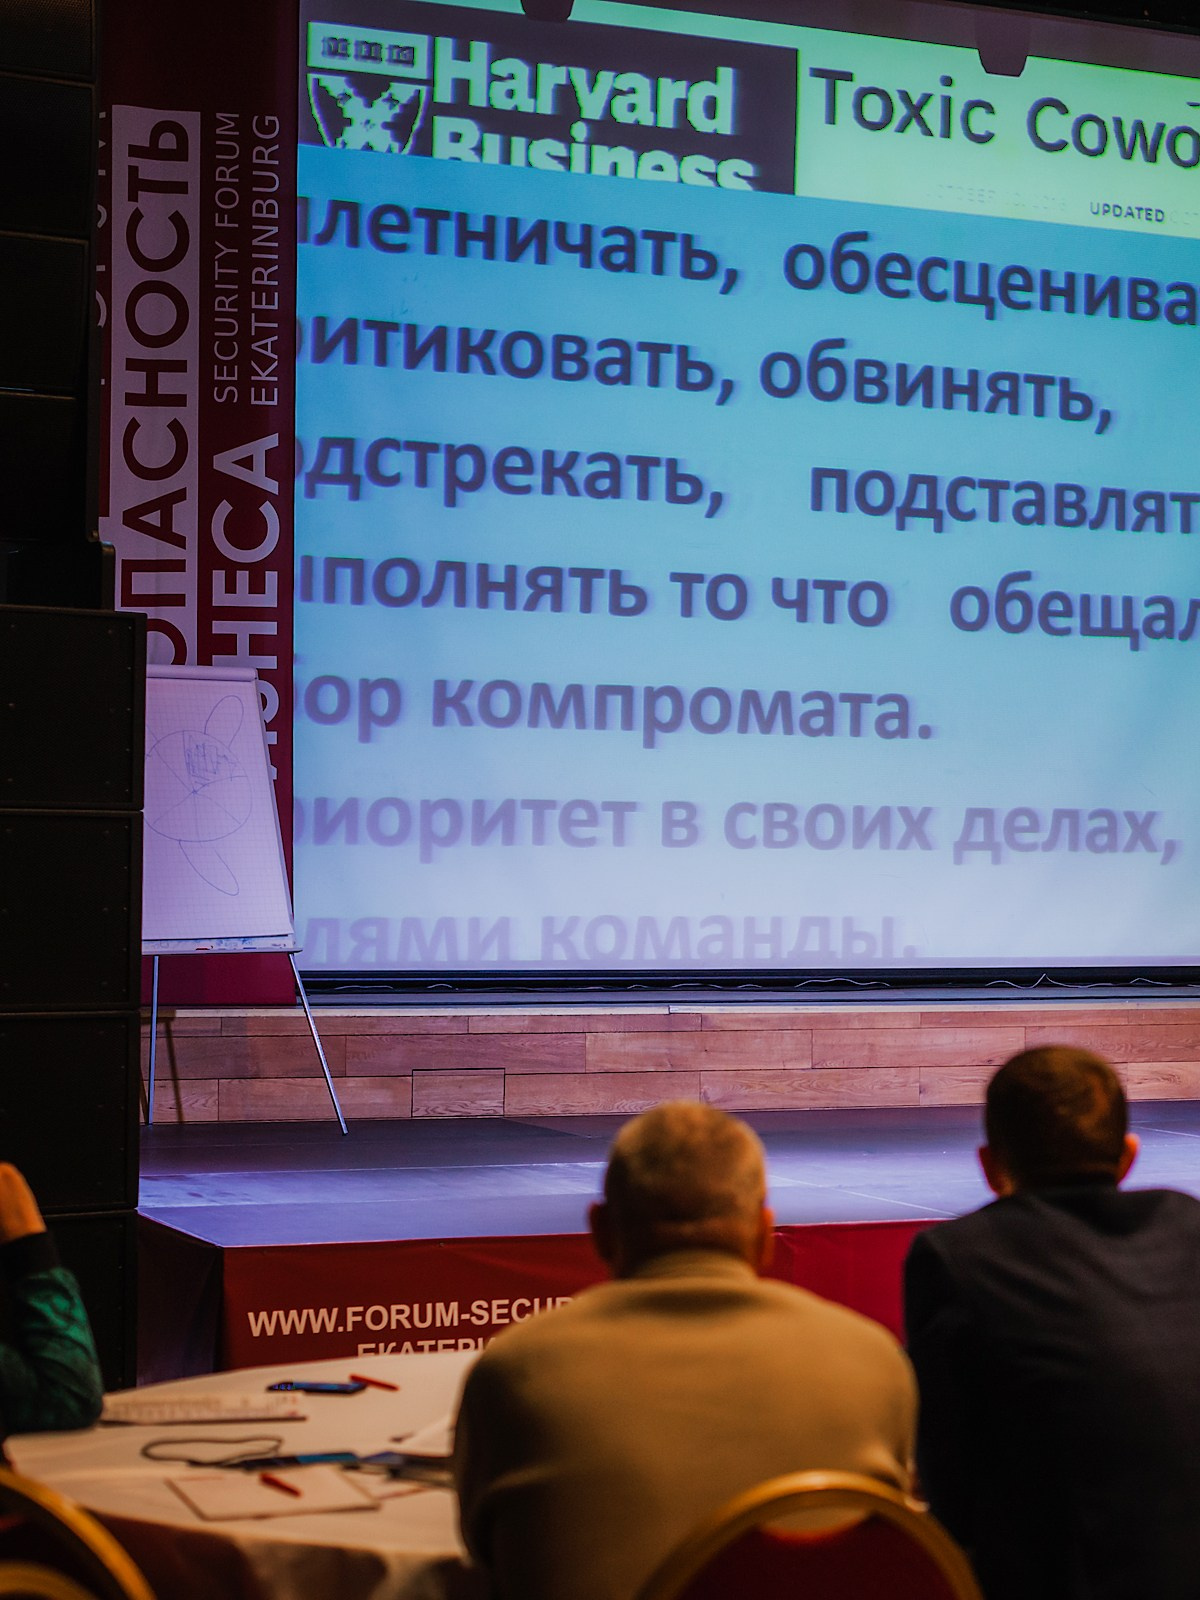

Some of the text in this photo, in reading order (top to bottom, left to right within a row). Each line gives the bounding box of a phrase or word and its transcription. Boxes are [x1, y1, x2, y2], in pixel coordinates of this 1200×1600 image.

[434, 36, 735, 135] Harvard
[808, 67, 996, 144] Toxic
[1089, 201, 1166, 223] UPDATED
[213, 112, 240, 403] SECURITY FORUM
[250, 115, 280, 406] EKATERINBURG
[296, 315, 1113, 435] итиковать, обвинять,
[295, 436, 725, 519] дстрекать,
[211, 432, 280, 780] НЕСА
[300, 554, 649, 618] полнять
[669, 571, 749, 622] то
[771, 577, 891, 627] что
[294, 662, 934, 749] ор компромата.
[294, 795, 638, 864] иоритет
[660, 800, 700, 849] в
[723, 801, 935, 851] своих
[953, 805, 1179, 866] делах,
[539, 913, 921, 969] команды.
